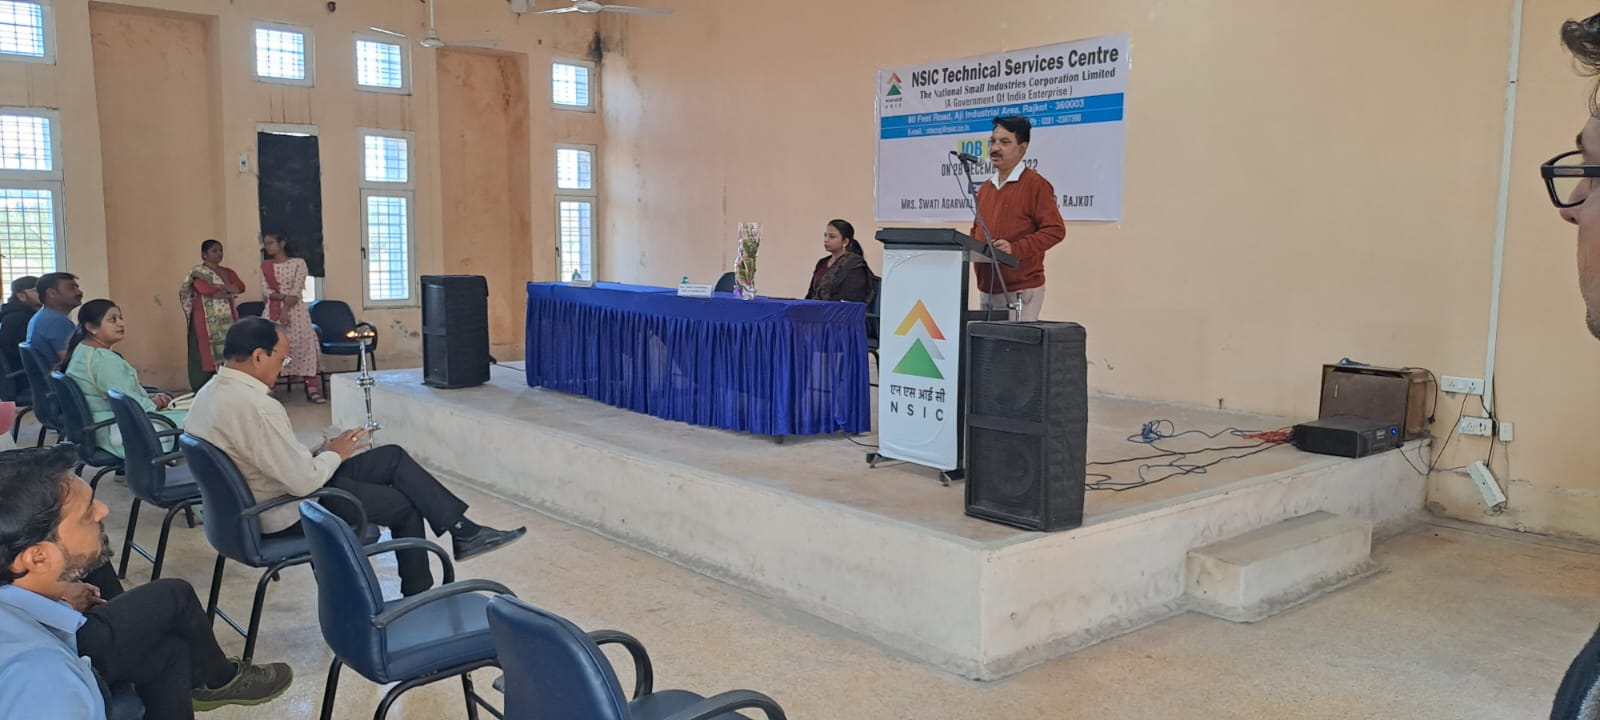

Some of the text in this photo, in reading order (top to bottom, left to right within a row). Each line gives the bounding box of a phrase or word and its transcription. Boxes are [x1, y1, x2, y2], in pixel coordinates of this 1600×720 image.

[912, 46, 1119, 88] NSIC Technical Services Centre
[920, 67, 1116, 99] The National Small Industries Corporation Limited
[953, 95, 995, 108] Government
[1007, 91, 1025, 102] India
[1028, 86, 1068, 100] Enterprise
[965, 106, 1000, 119] Industrial
[1022, 103, 1048, 114] Rajkot
[1055, 99, 1085, 110] 360003
[961, 140, 982, 157] JOB
[941, 163, 950, 176] ON
[1062, 194, 1094, 207] RAJKOT
[890, 384, 945, 403] एन एस आई सी
